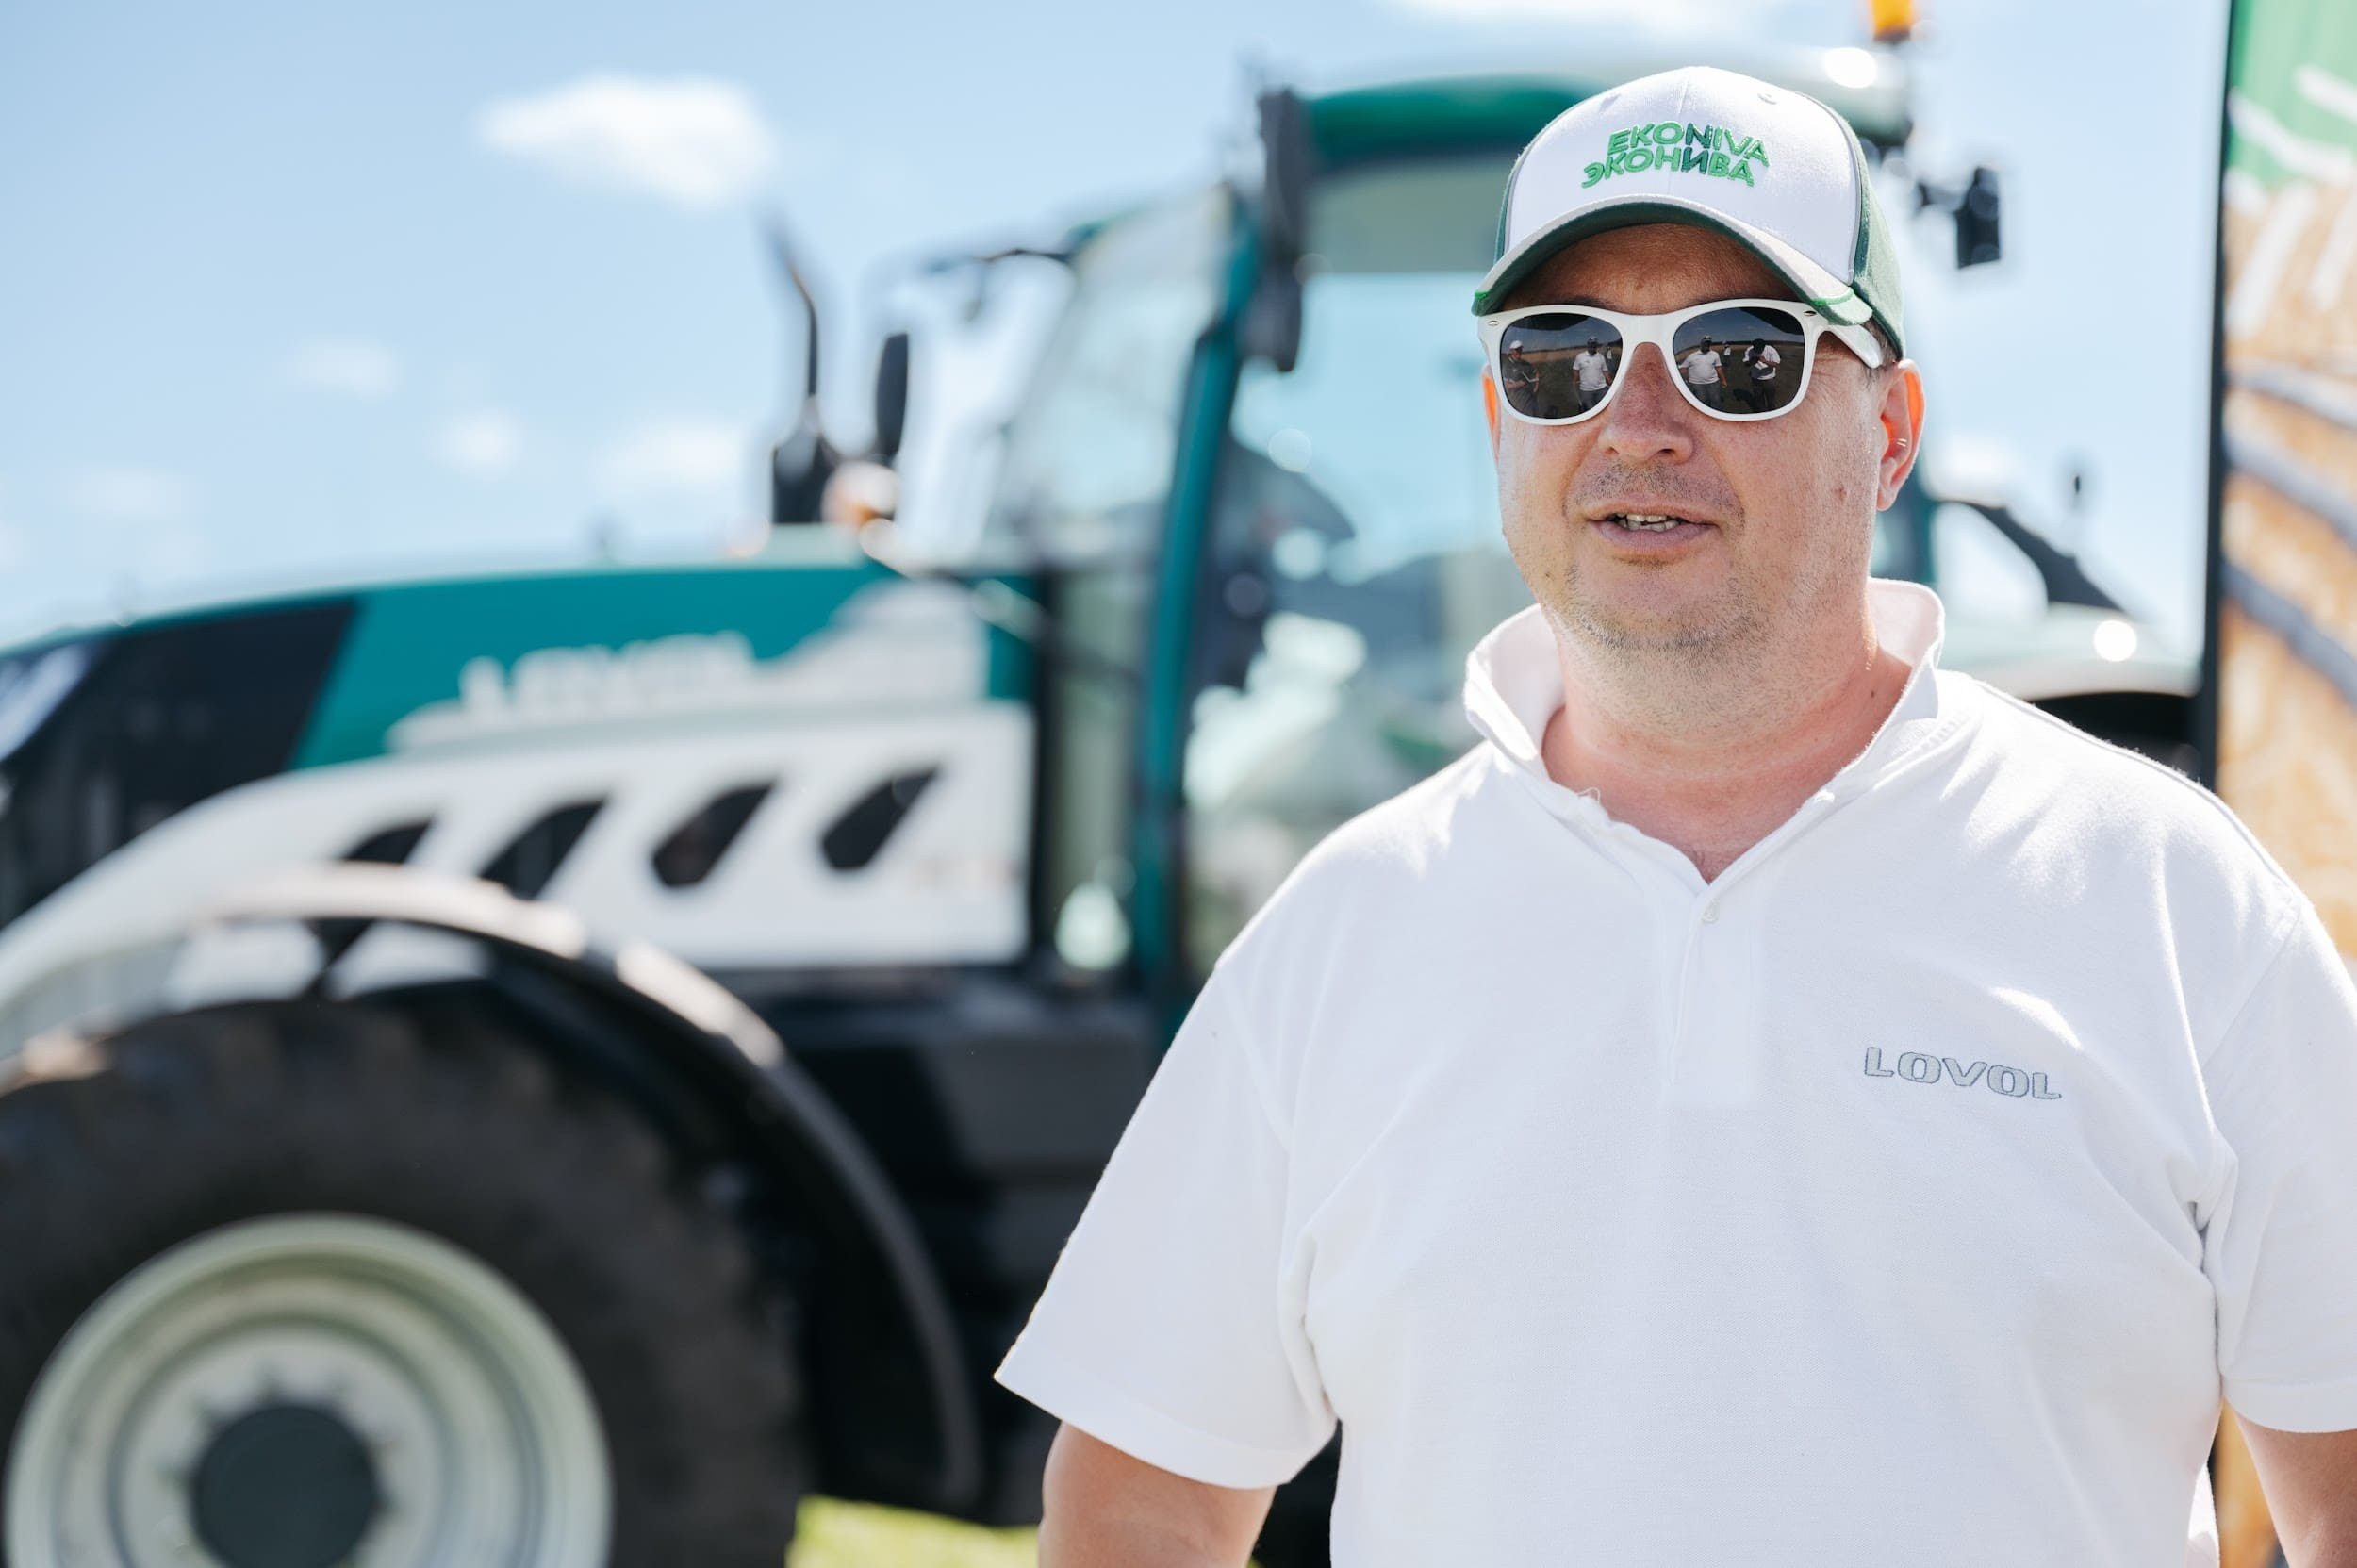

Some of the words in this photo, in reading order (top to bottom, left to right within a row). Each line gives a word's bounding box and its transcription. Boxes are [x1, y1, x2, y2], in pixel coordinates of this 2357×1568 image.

[1607, 122, 1770, 166] EKONIVA
[1581, 146, 1755, 189] ЭКОНИВА
[1864, 1047, 2062, 1099] LOVOL
